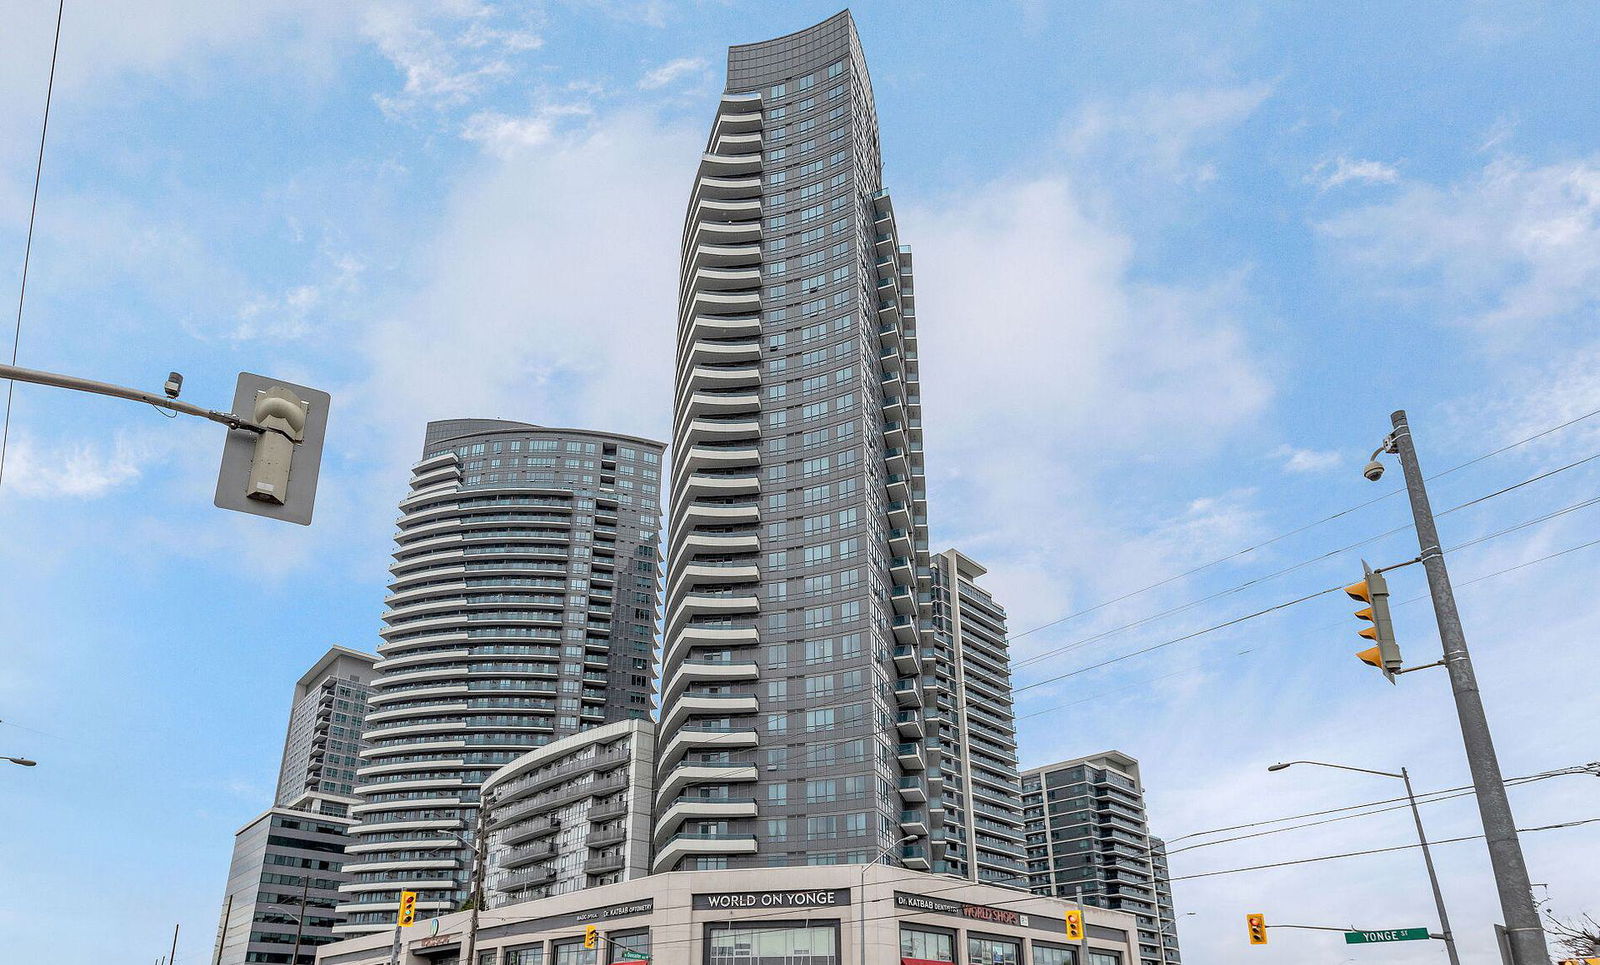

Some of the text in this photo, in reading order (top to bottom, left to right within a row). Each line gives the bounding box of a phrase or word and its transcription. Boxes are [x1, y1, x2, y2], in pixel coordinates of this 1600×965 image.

[708, 892, 835, 907] WORLD ON YONGE
[908, 898, 934, 909] KATBAB
[963, 906, 992, 920] WORLD
[992, 909, 1019, 924] SHOPS
[1363, 931, 1399, 942] YONGE
